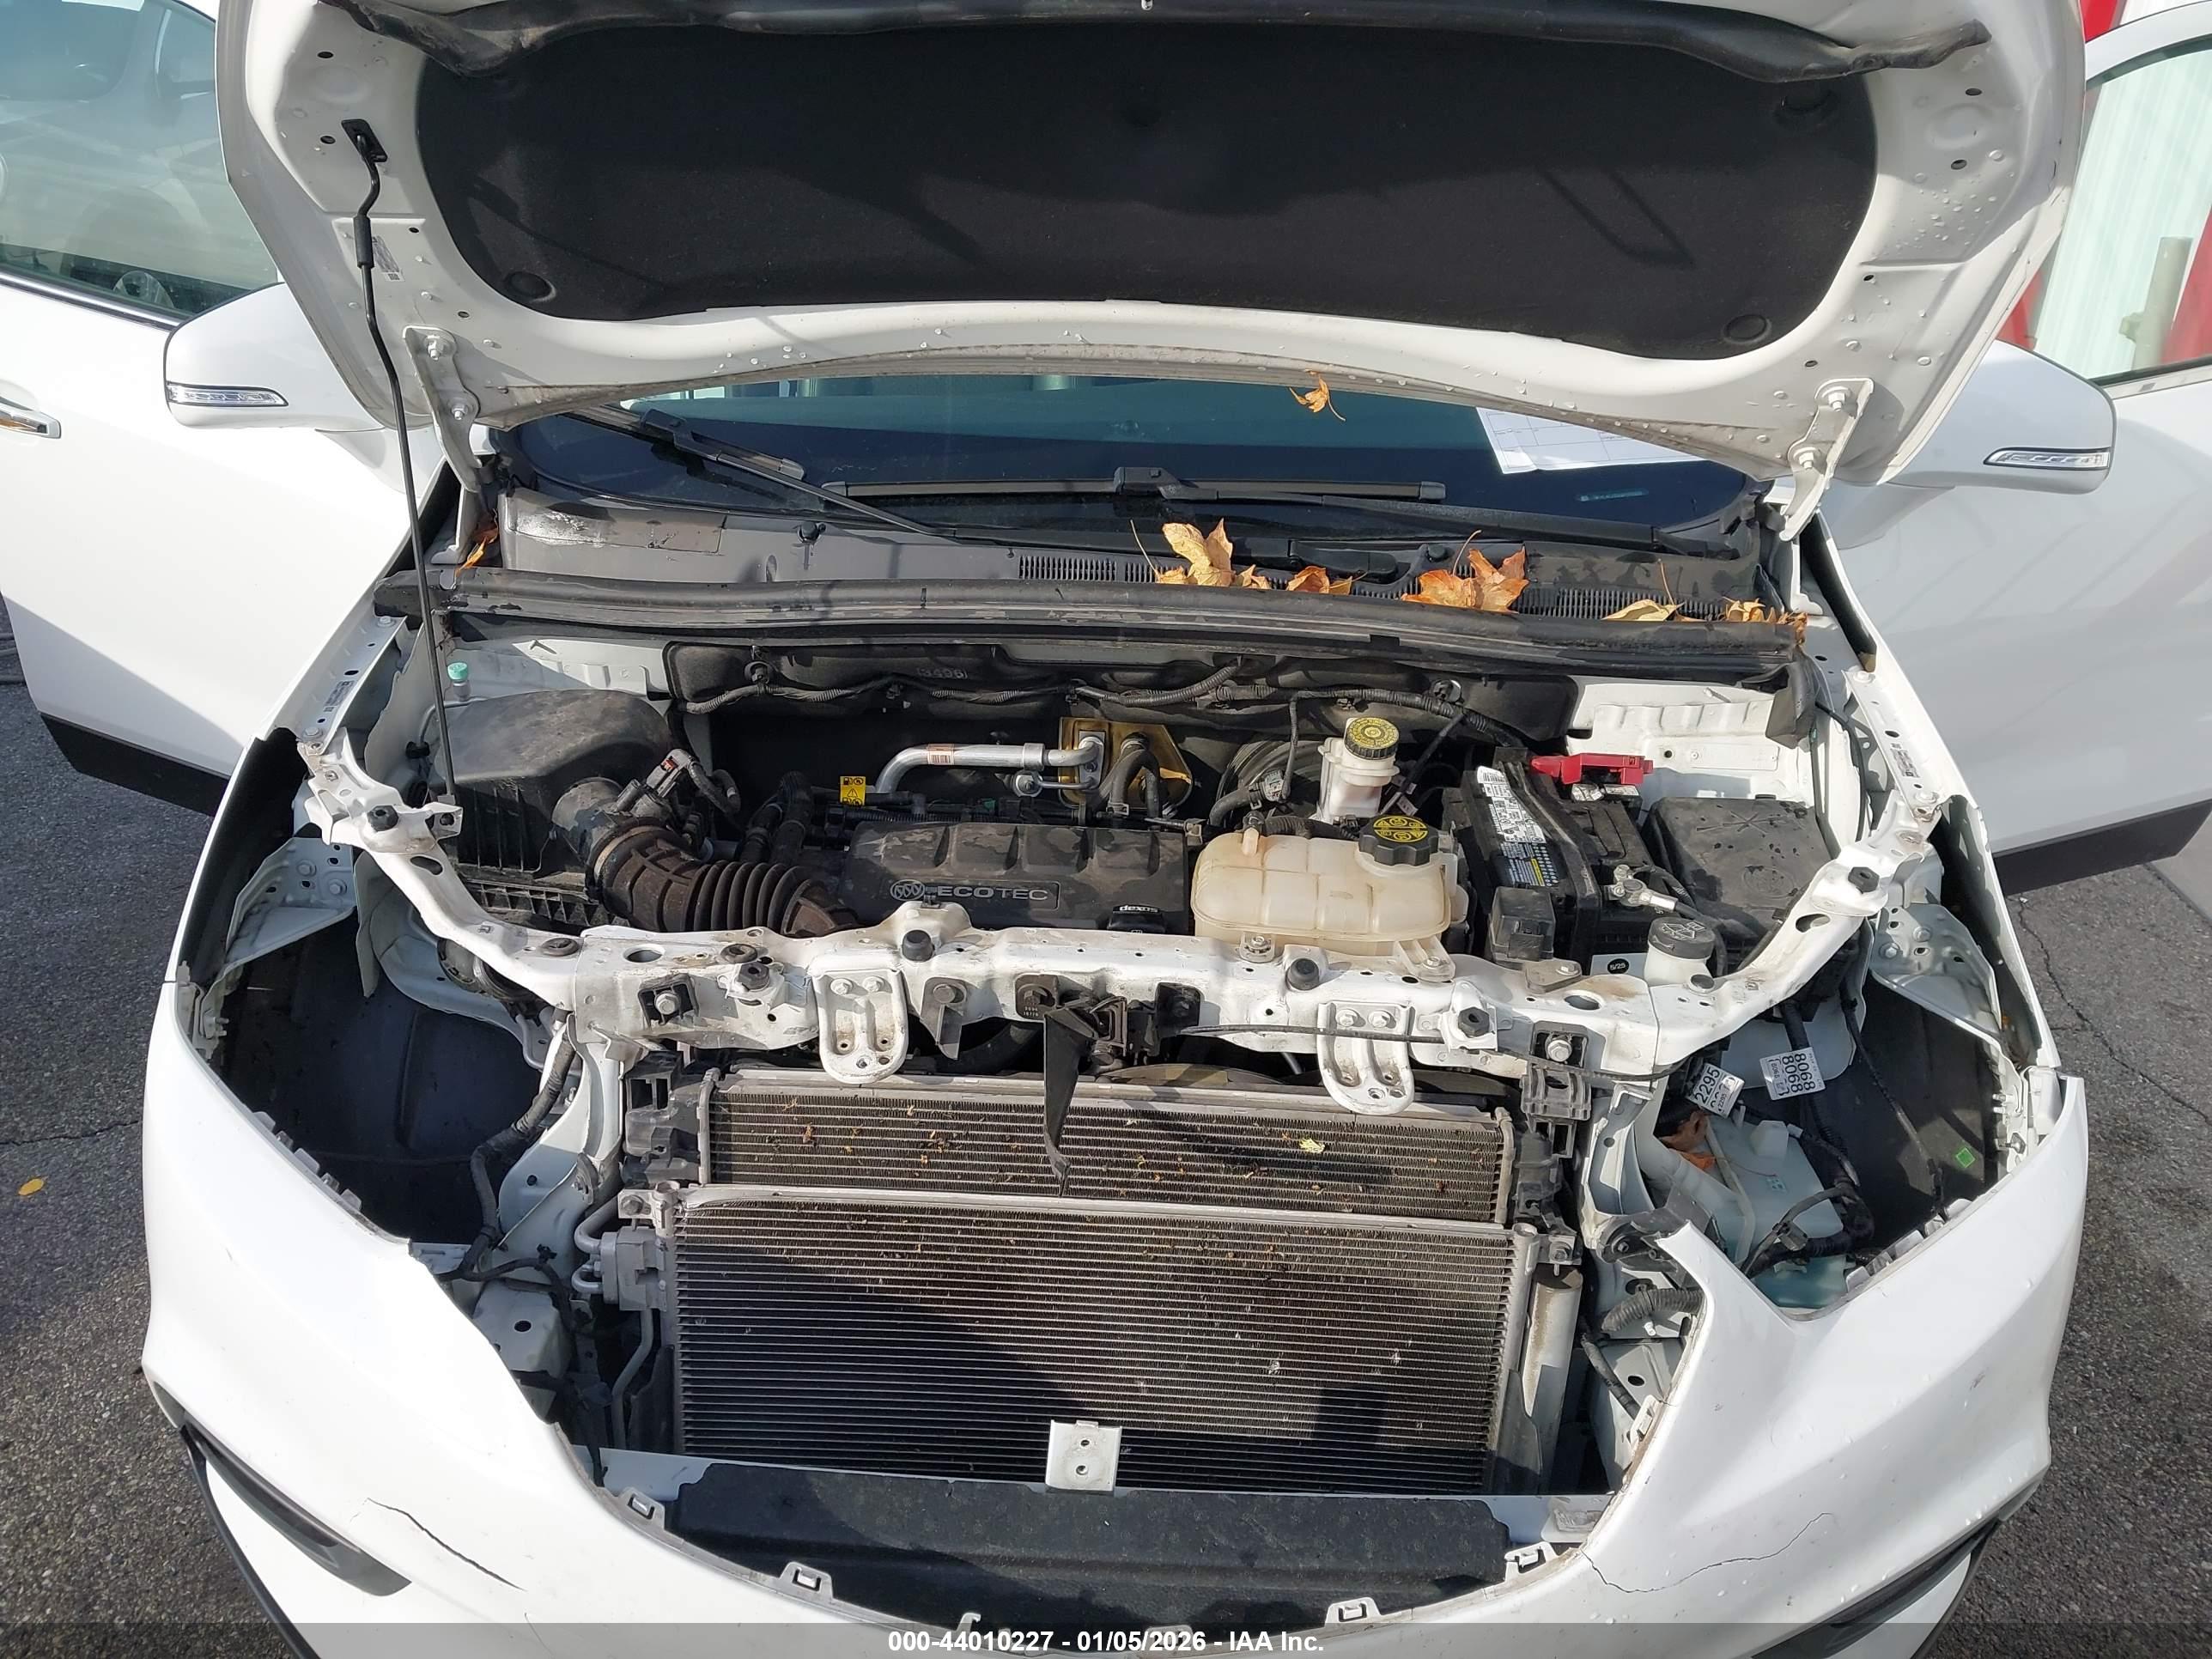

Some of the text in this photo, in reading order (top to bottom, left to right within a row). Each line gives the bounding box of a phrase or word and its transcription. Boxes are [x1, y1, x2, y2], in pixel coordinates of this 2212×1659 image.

[937, 886, 1048, 901] ECOTEC
[1119, 904, 1158, 913] dexos
[1694, 1066, 1721, 1104] 2295
[1782, 1055, 1803, 1093] 8068
[1794, 1053, 1816, 1091] 8068
